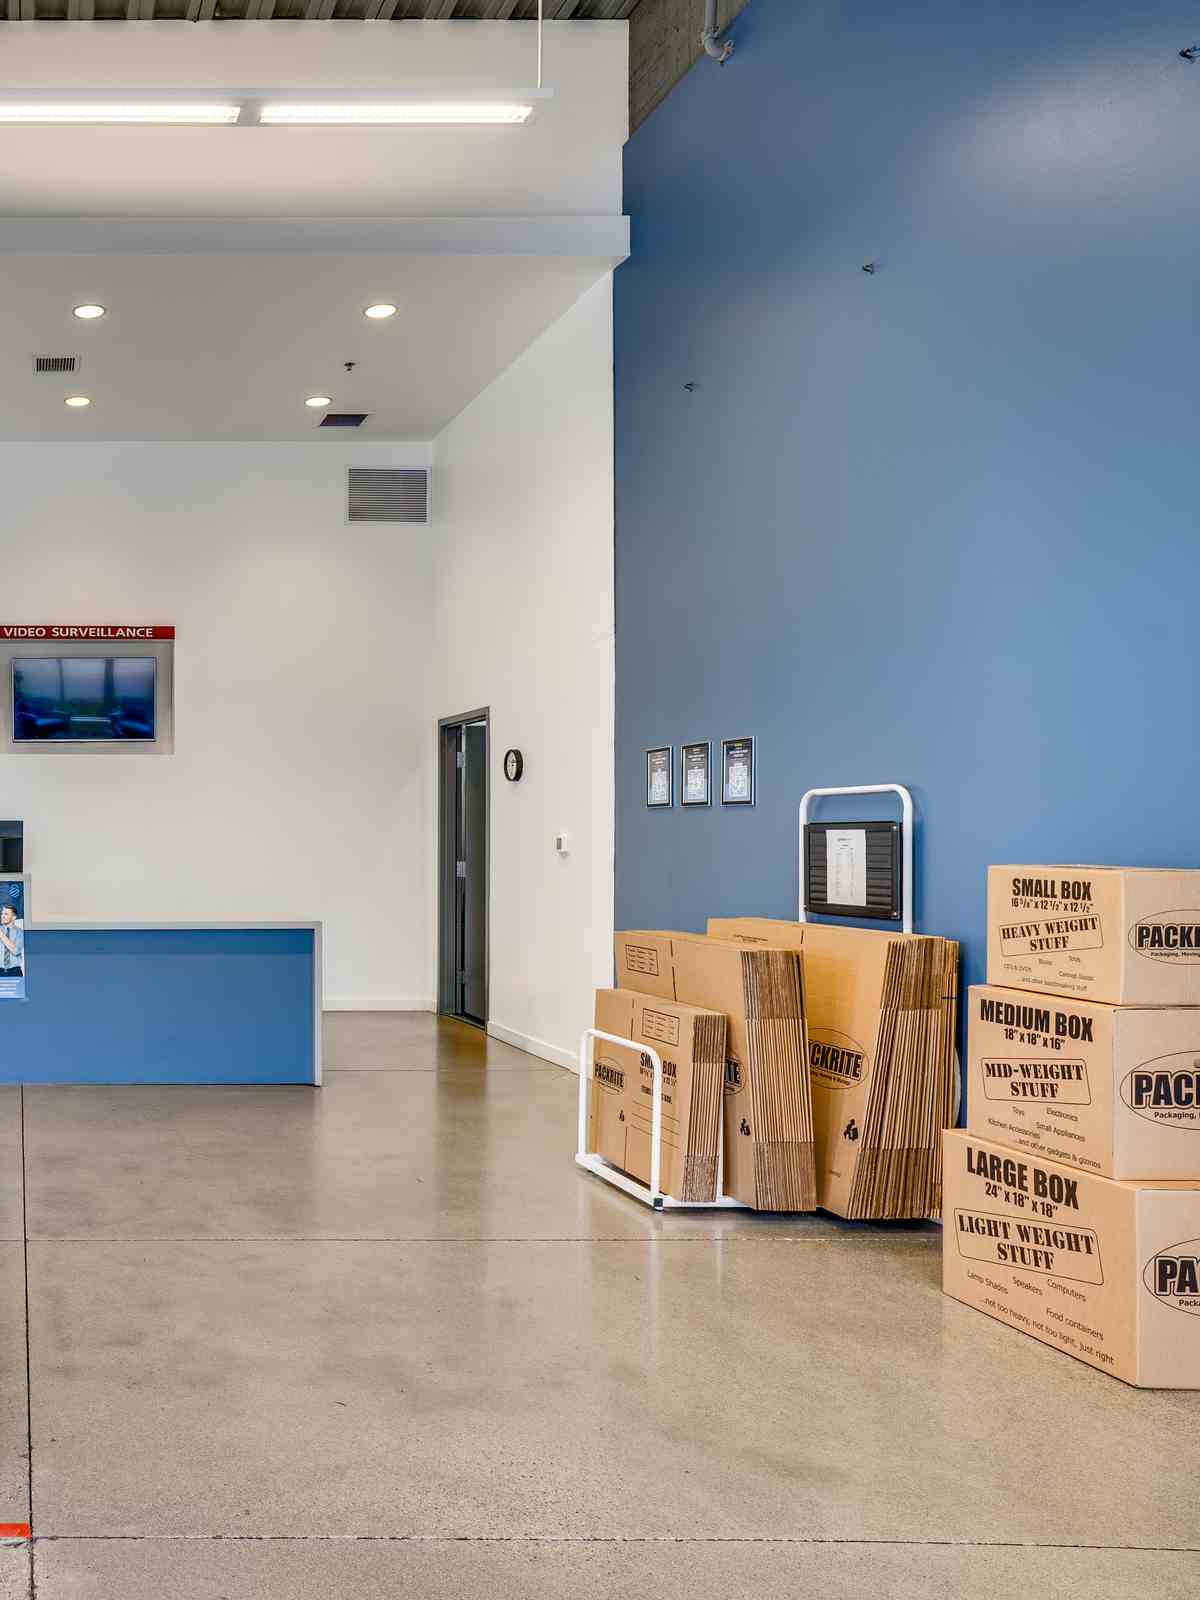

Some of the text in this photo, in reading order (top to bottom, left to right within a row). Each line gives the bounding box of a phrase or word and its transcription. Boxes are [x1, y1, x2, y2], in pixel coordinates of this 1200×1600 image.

[3, 627, 47, 638] VIDEO
[52, 628, 153, 638] SURVEILLANCE
[1012, 878, 1092, 901] SMALL BOX
[1002, 917, 1098, 939] HEAVY WEIGHT
[1135, 923, 1200, 950] PACK
[1029, 935, 1070, 951] STUFF
[980, 999, 1094, 1042] MEDIUM BOX
[1004, 1028, 1018, 1040] 18"
[1027, 1031, 1041, 1045] 18"
[1049, 1036, 1066, 1050] 16"
[662, 1060, 677, 1078] BOX
[984, 1063, 1084, 1081] MID-WEIGHT
[1010, 1082, 1059, 1098] STUFF
[1131, 1070, 1200, 1109] PAC
[966, 1146, 1079, 1210] LARGE BOX
[985, 1181, 1003, 1199] 24"
[1013, 1192, 1030, 1209] 18"
[1040, 1200, 1059, 1218] 18"
[958, 1214, 1095, 1255] LIGHT WEIGHT
[997, 1242, 1055, 1270] STUFF
[1012, 1276, 1043, 1296] Speakers
[1047, 1279, 1086, 1302] Computers
[1046, 1307, 1104, 1341] Food containers
[1032, 1319, 1044, 1331] not
[1045, 1326, 1058, 1337] too
[1095, 1350, 1115, 1365] right
